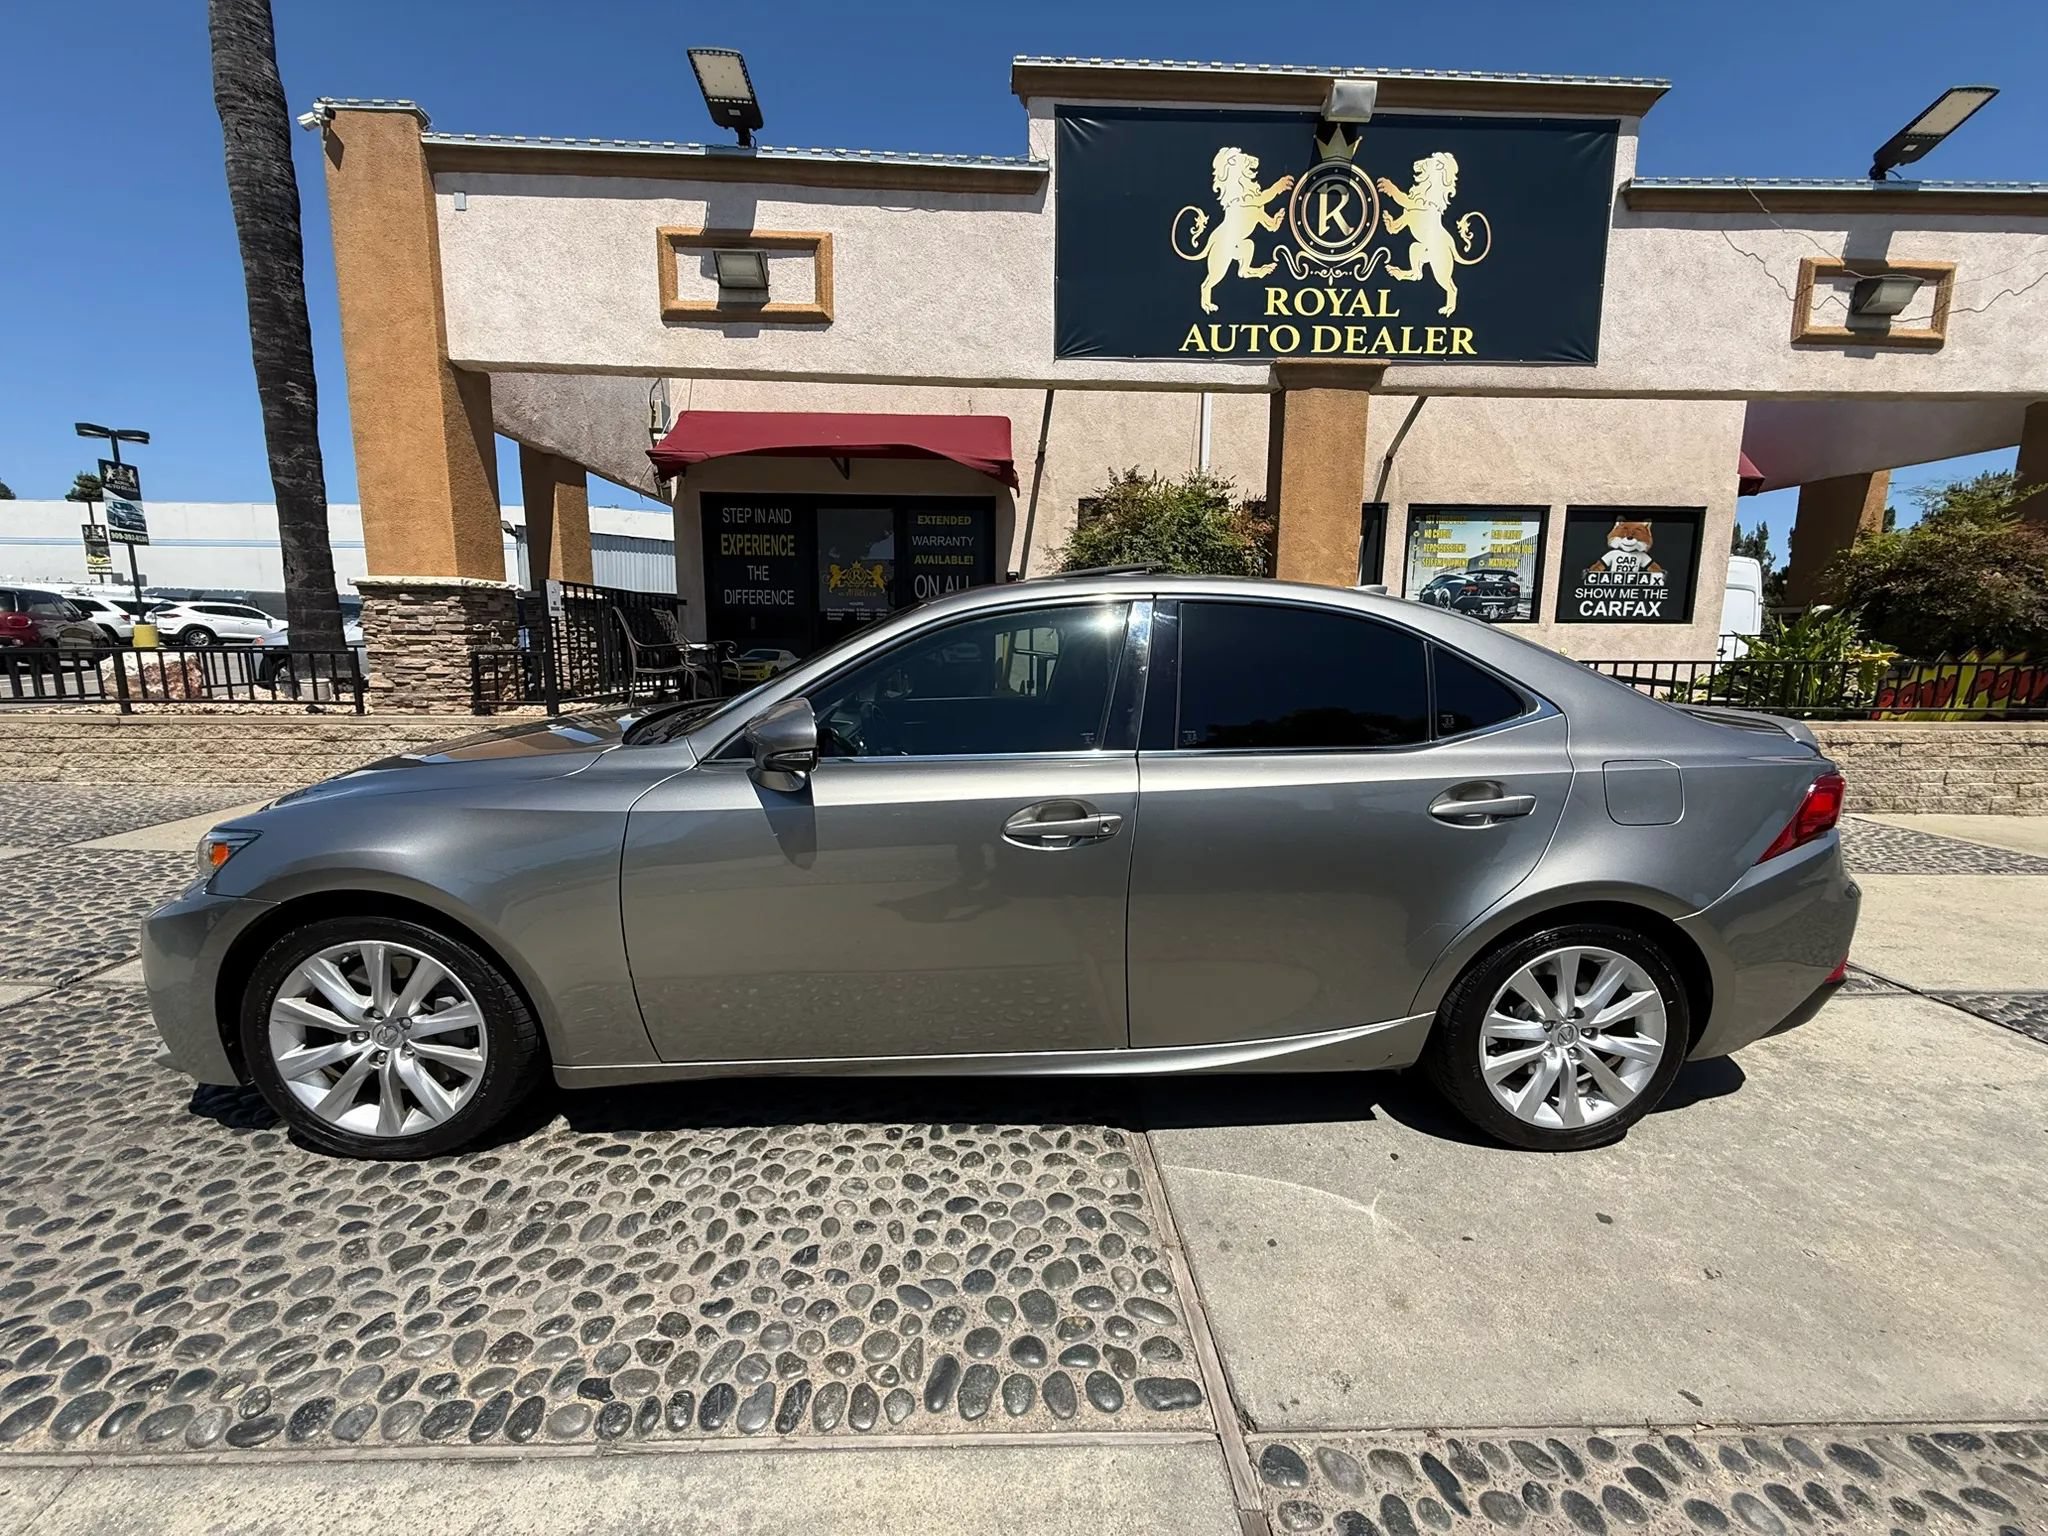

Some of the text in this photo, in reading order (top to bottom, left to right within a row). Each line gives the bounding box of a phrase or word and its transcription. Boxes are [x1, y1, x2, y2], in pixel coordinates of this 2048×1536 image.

[1264, 287, 1400, 317] ROYAL
[1178, 323, 1478, 355] AUTO DEALER
[722, 507, 792, 524] STEP IN AND
[917, 515, 972, 525] EXTENDED
[721, 533, 796, 557] EXPERIENCE
[911, 535, 975, 547] WARRANTY
[1616, 556, 1637, 565] CAR
[1616, 564, 1635, 573] FOX
[747, 565, 770, 581] THE
[914, 574, 940, 599] ON
[1574, 588, 1669, 600] SHOW ME THE
[724, 589, 796, 606] DIFFERENCE
[1579, 600, 1662, 617] CARFAX
